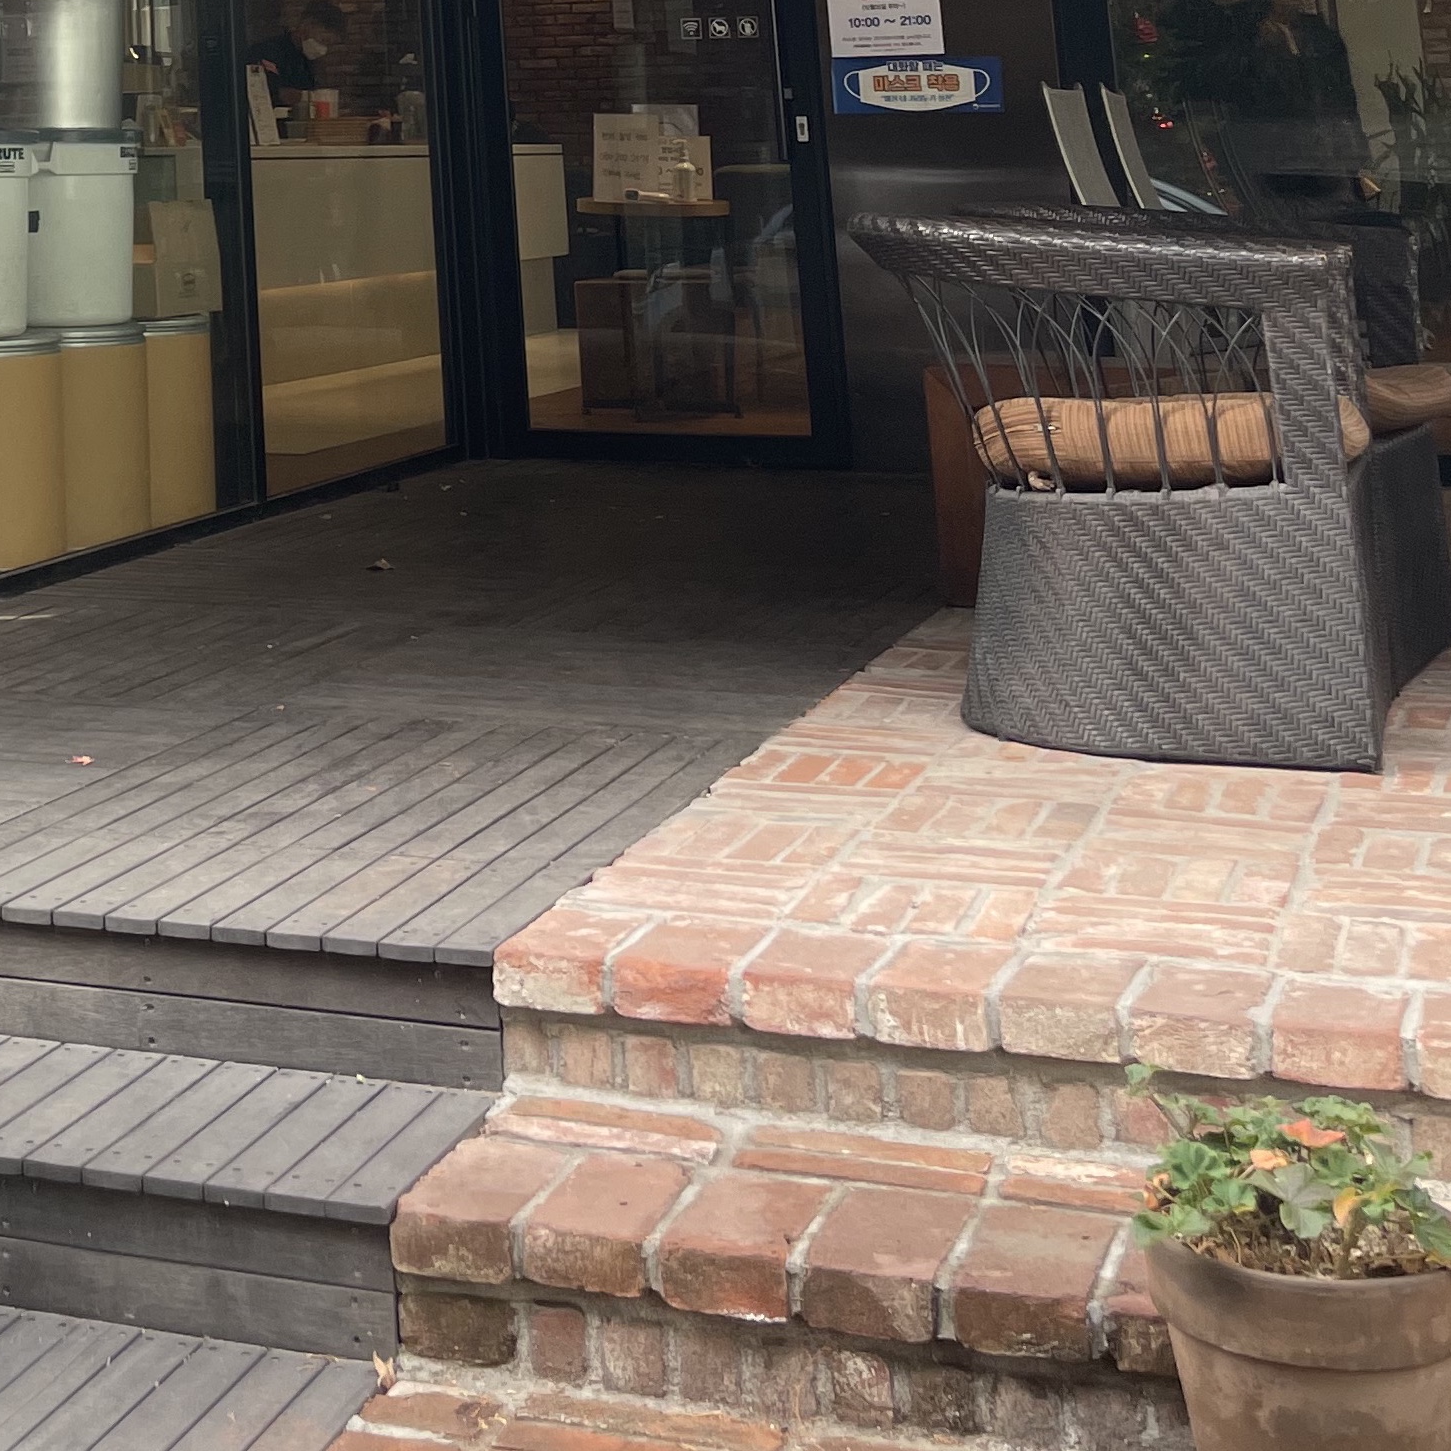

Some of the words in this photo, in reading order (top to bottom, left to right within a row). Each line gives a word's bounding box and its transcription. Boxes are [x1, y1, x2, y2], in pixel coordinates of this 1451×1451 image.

[849, 17, 880, 28] 10:00
[900, 15, 932, 27] 21:00
[873, 74, 922, 92] 마스크
[927, 73, 960, 92] 착용
